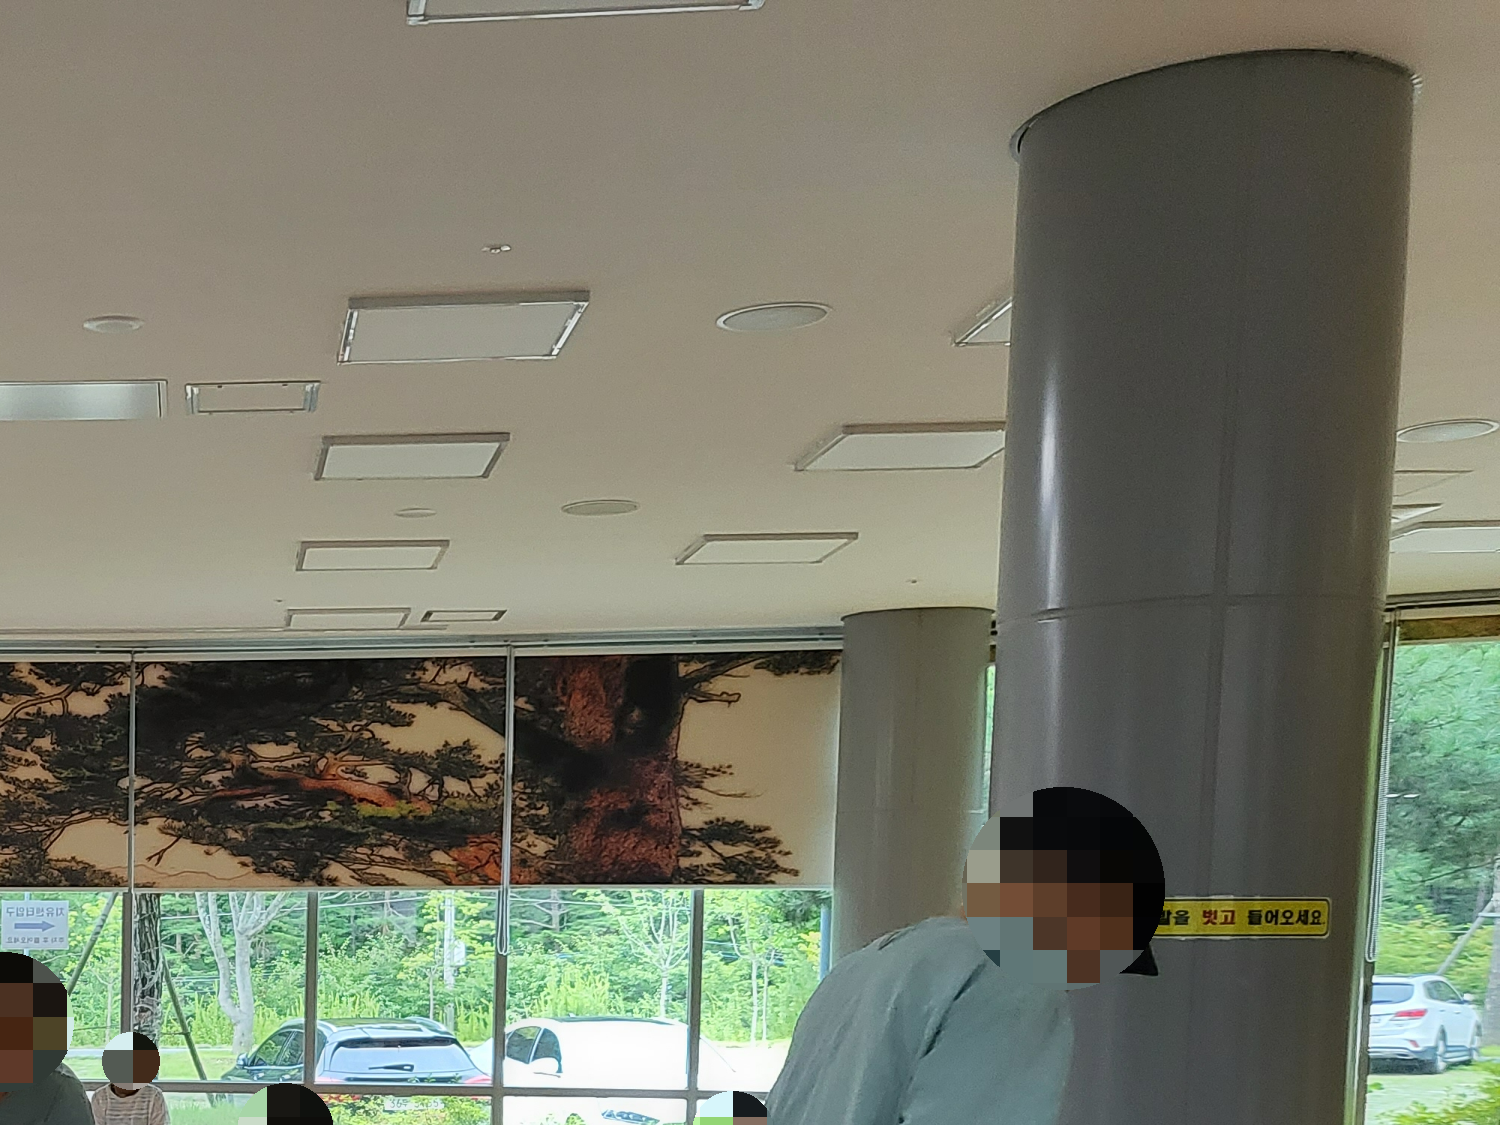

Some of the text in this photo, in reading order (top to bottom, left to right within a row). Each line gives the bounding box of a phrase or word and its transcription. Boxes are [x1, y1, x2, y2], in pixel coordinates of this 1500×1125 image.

[1158, 909, 1326, 926] 발을 벗고 들어오세요.
